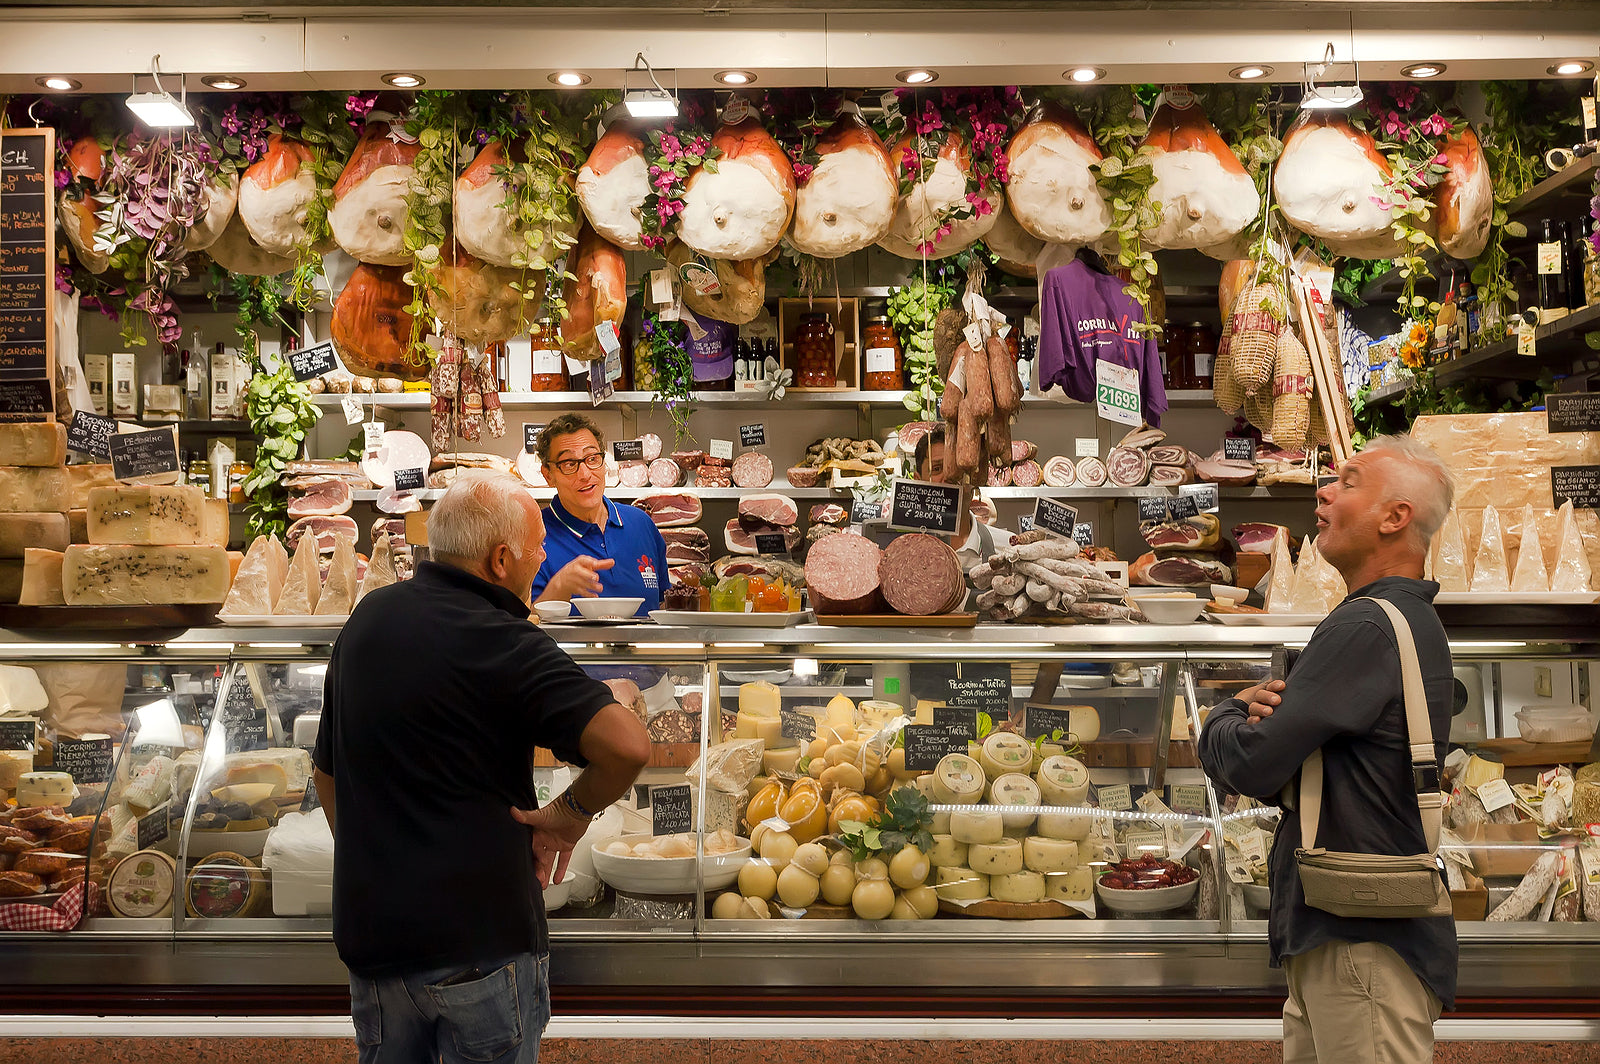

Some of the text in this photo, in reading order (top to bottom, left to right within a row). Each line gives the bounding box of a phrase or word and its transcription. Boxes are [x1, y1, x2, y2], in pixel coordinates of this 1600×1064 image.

[1077, 318, 1106, 332] CORRI
[1107, 319, 1118, 332] LA
[1099, 386, 1139, 411] 21693
[76, 411, 116, 430] PECORINO
[123, 433, 163, 447] PECORINO
[900, 485, 945, 497] SBRICIOLONA
[896, 492, 953, 506] SENZA GLUTINE
[925, 503, 947, 513] FREE
[947, 678, 978, 690] PECORINO
[959, 689, 999, 698] STAGIONATO
[58, 742, 97, 752] PECORINO
[917, 736, 950, 747] FRESCO
